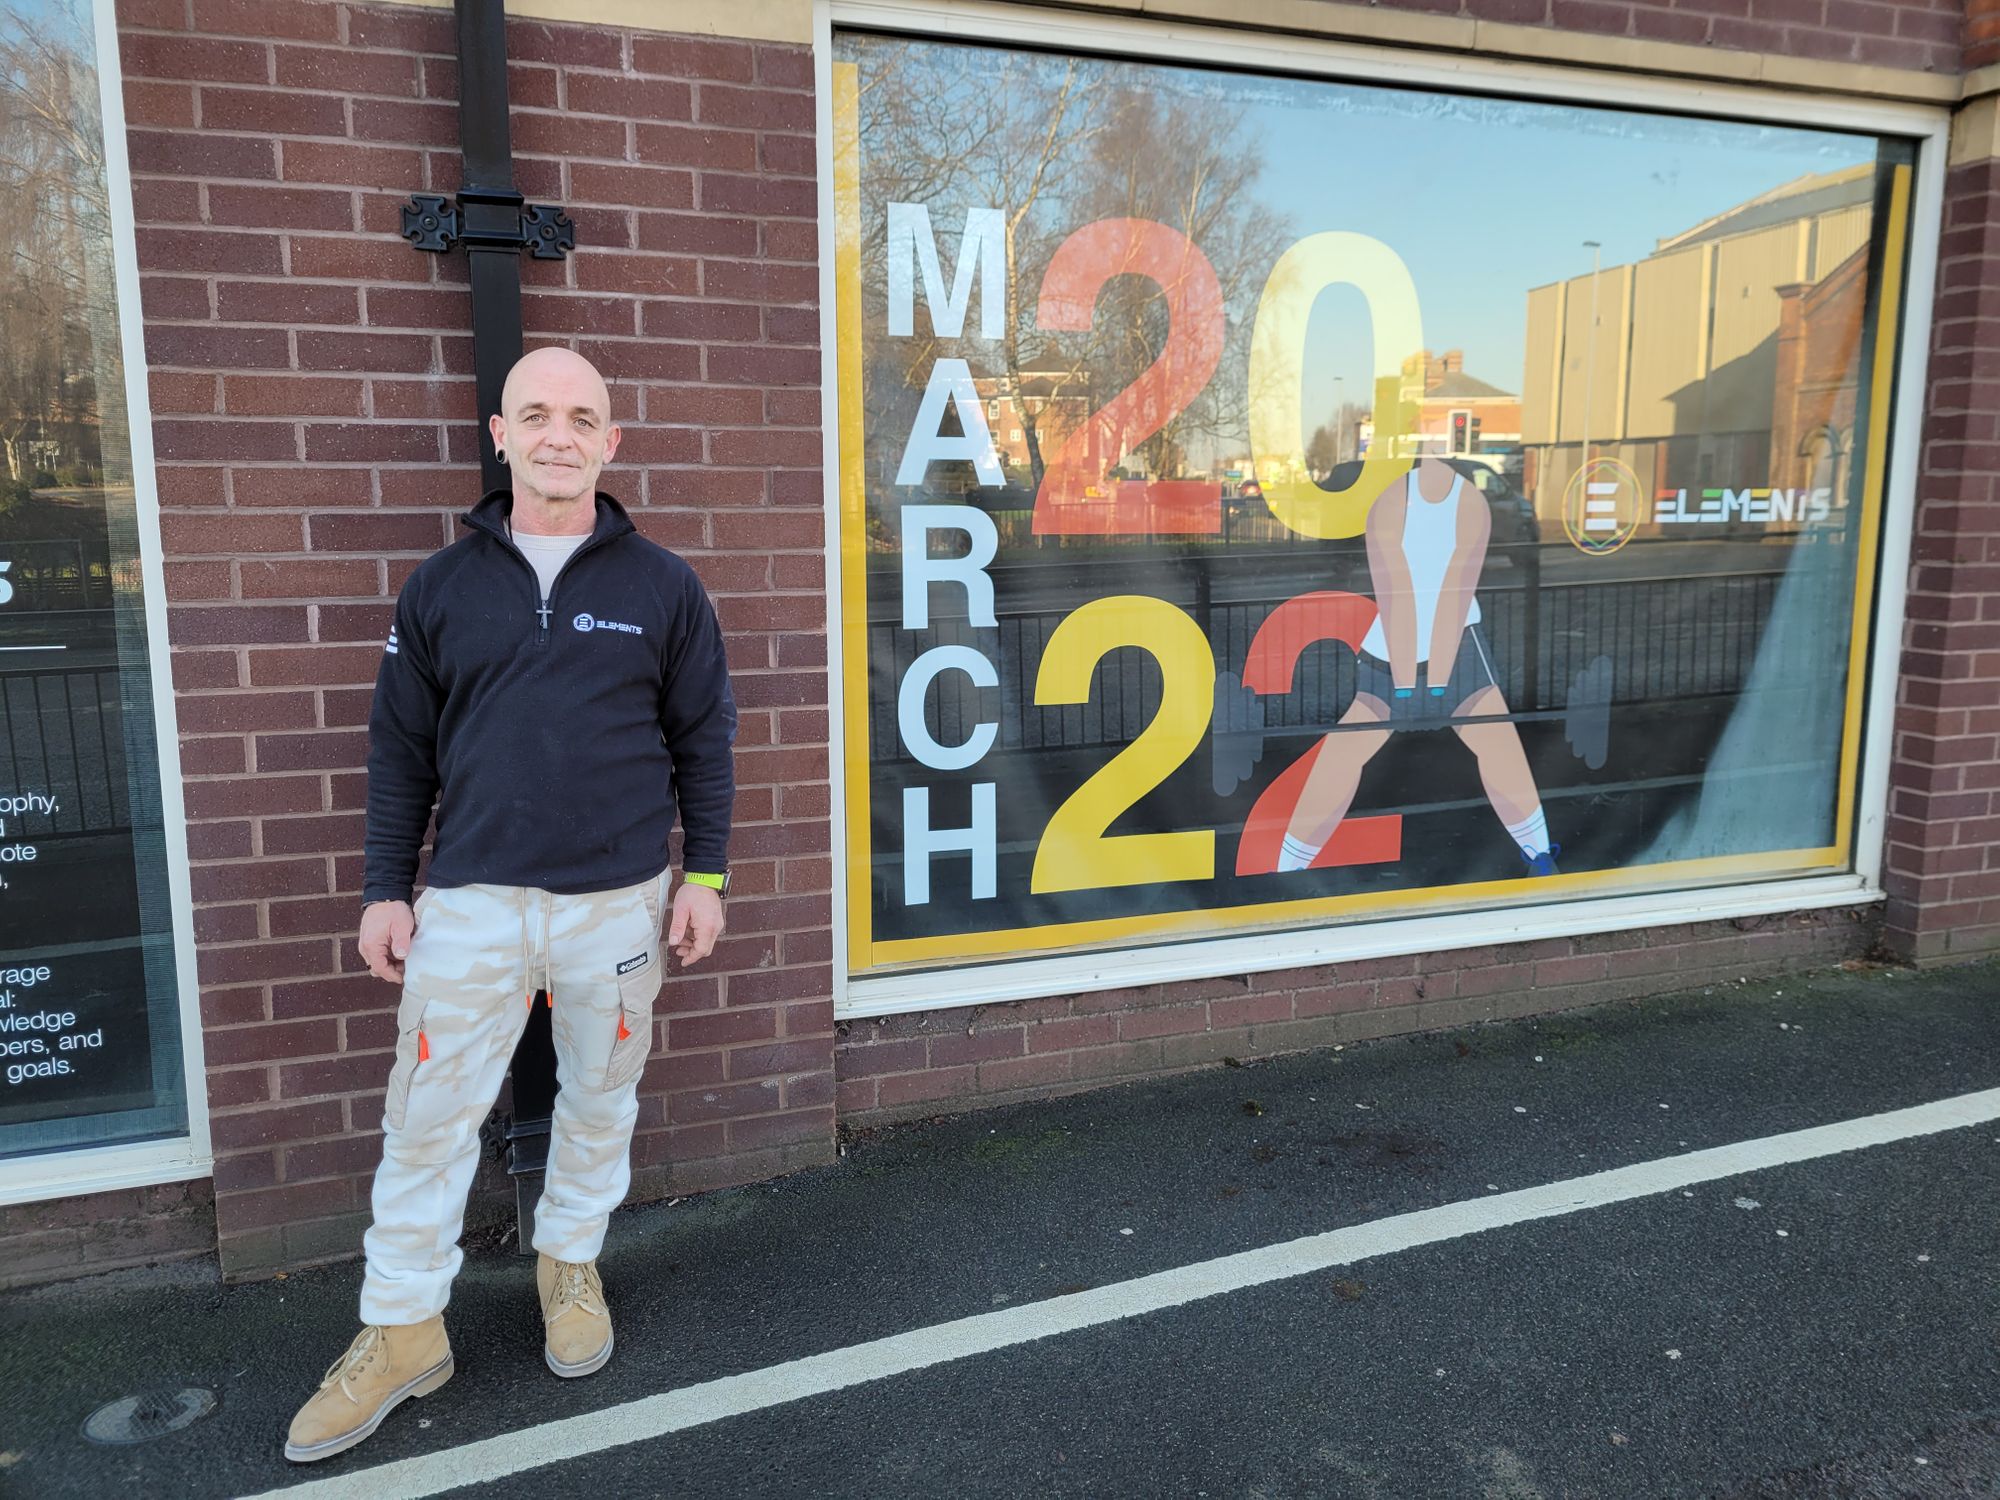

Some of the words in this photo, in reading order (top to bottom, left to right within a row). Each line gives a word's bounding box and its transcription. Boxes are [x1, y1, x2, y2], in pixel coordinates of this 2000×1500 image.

[1031, 216, 1426, 540] 20
[1654, 488, 1832, 523] ELEMENTS
[886, 201, 1006, 906] MARCH
[596, 620, 642, 634] ELEMENTS
[59, 1028, 103, 1050] and
[7, 1057, 75, 1084] goals.
